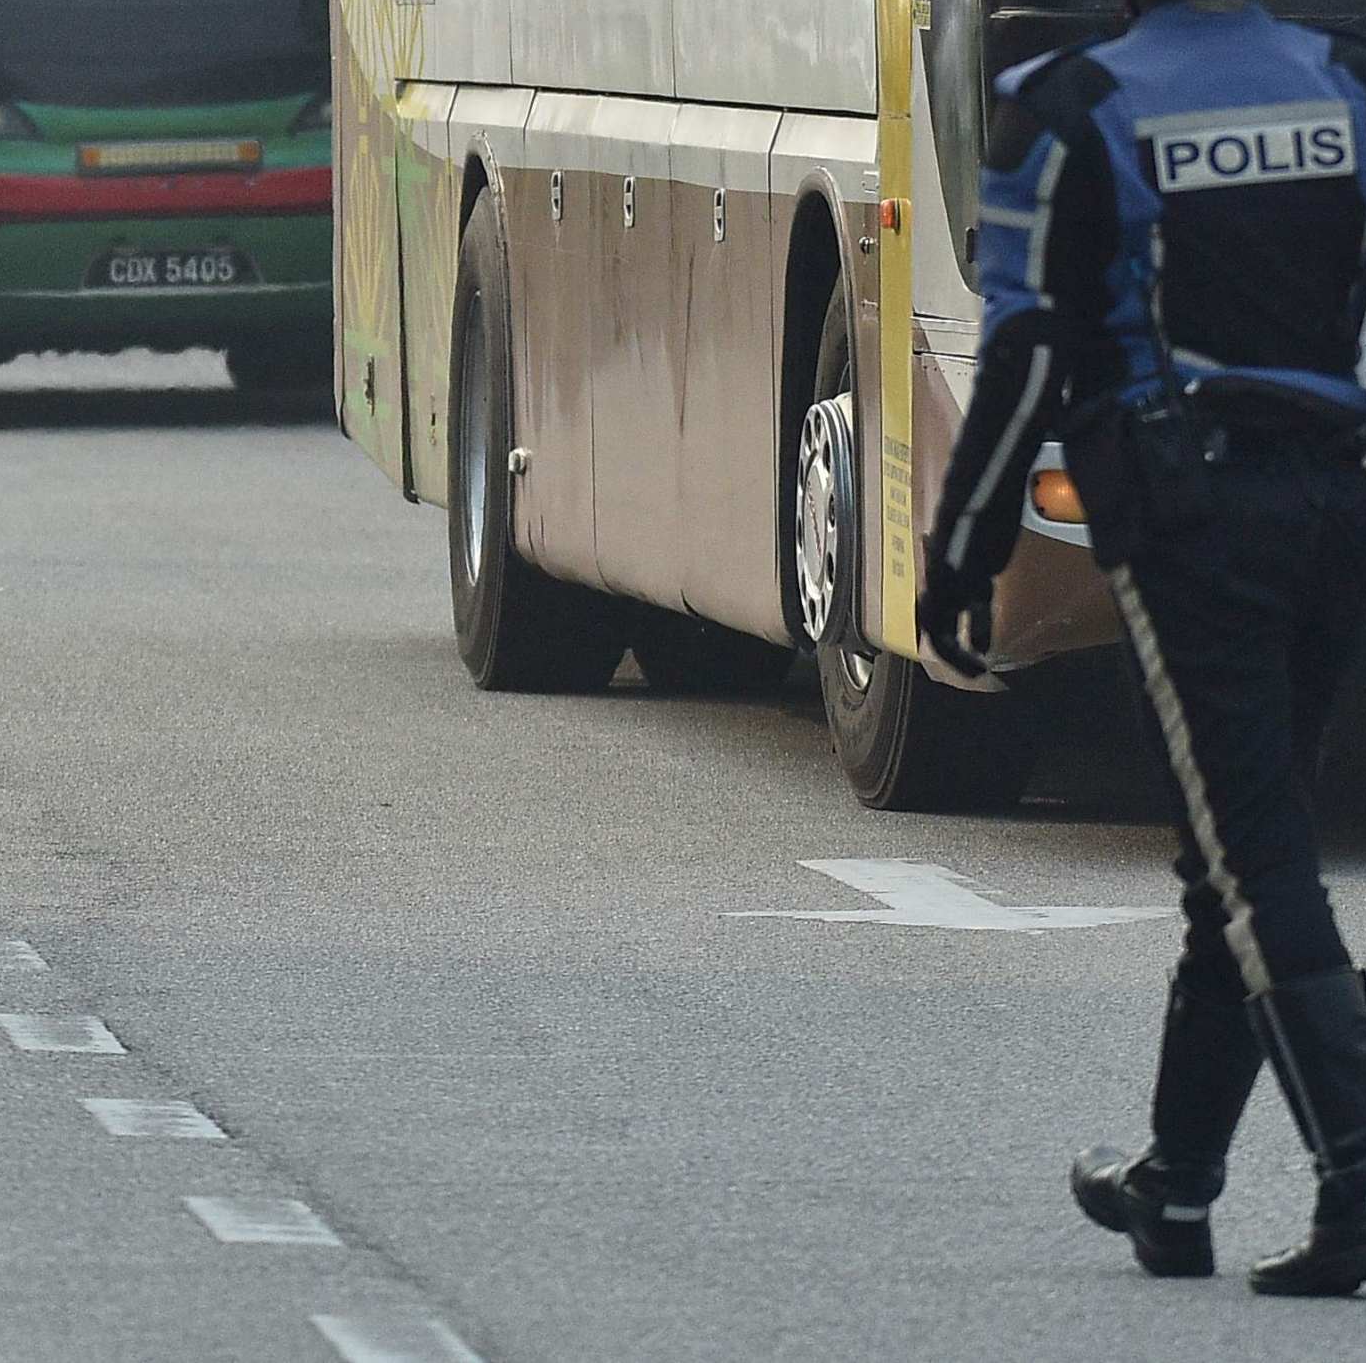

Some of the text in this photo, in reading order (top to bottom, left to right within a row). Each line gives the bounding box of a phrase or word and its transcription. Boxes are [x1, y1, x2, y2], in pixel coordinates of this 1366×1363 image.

[1164, 127, 1345, 181] POLIS
[109, 255, 234, 284] CDX 5405
